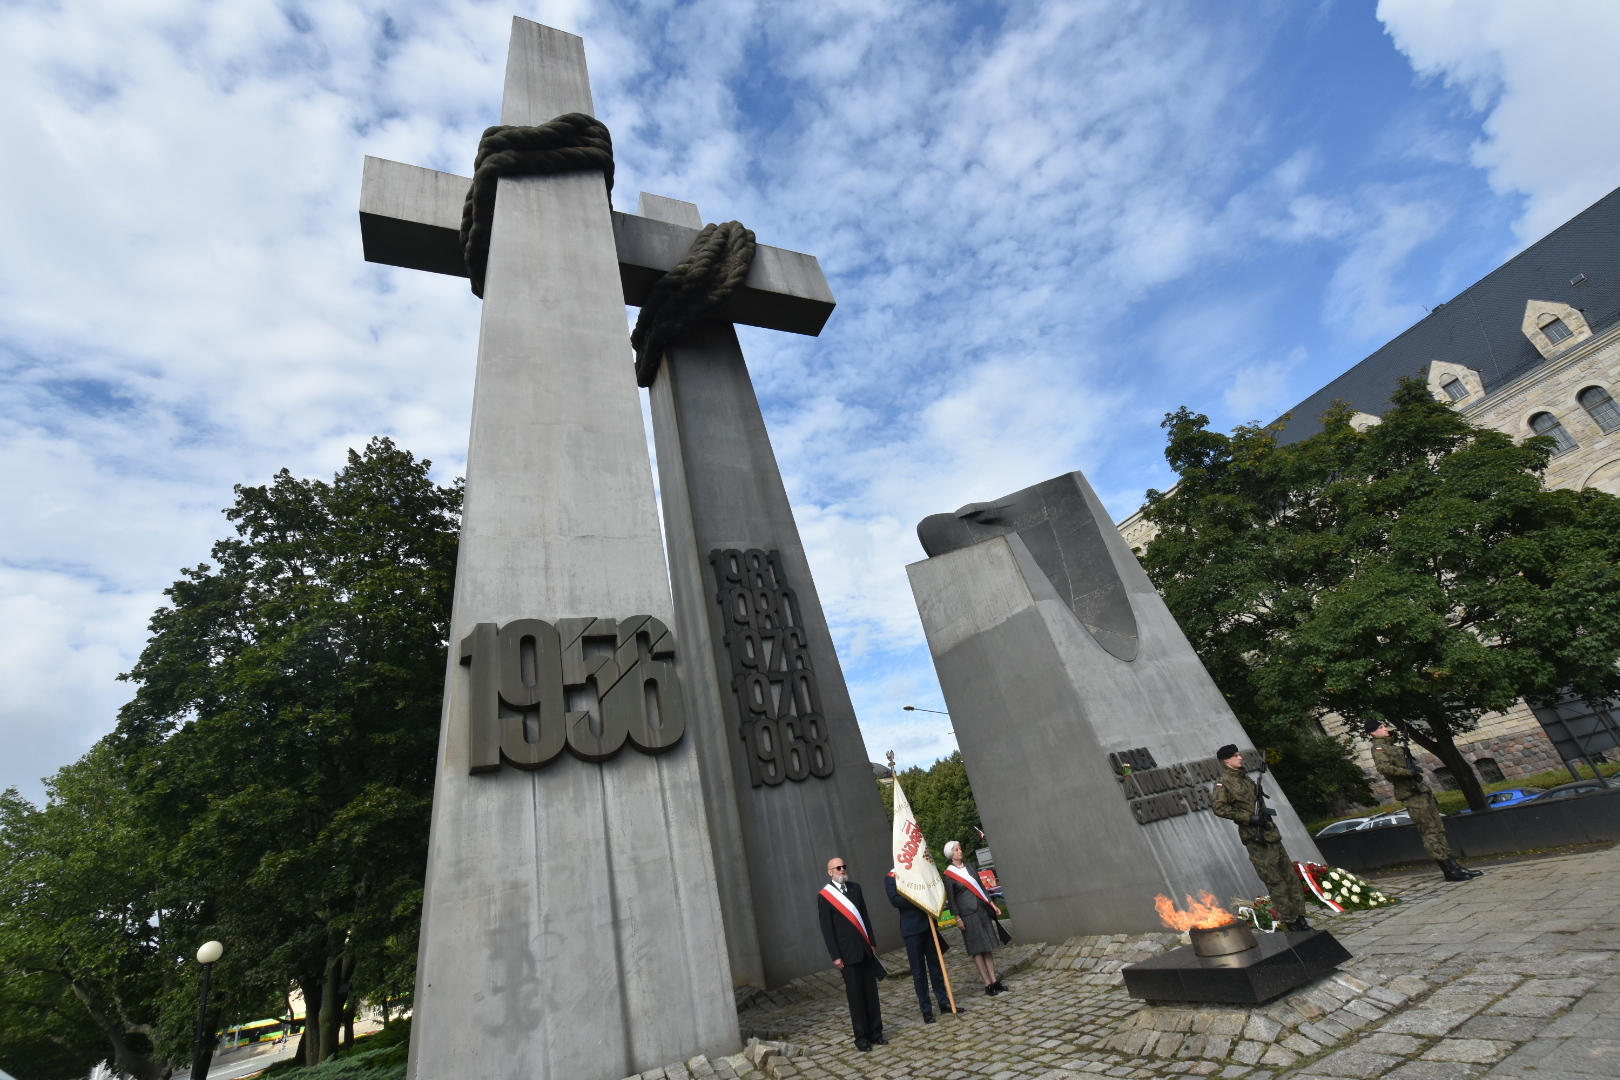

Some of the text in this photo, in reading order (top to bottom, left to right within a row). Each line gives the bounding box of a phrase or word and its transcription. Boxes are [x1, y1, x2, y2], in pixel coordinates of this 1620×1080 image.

[708, 548, 789, 592] 1981
[716, 585, 807, 639] 1980
[459, 614, 685, 775] 1956
[731, 668, 823, 727] 1970
[739, 712, 834, 788] 1968
